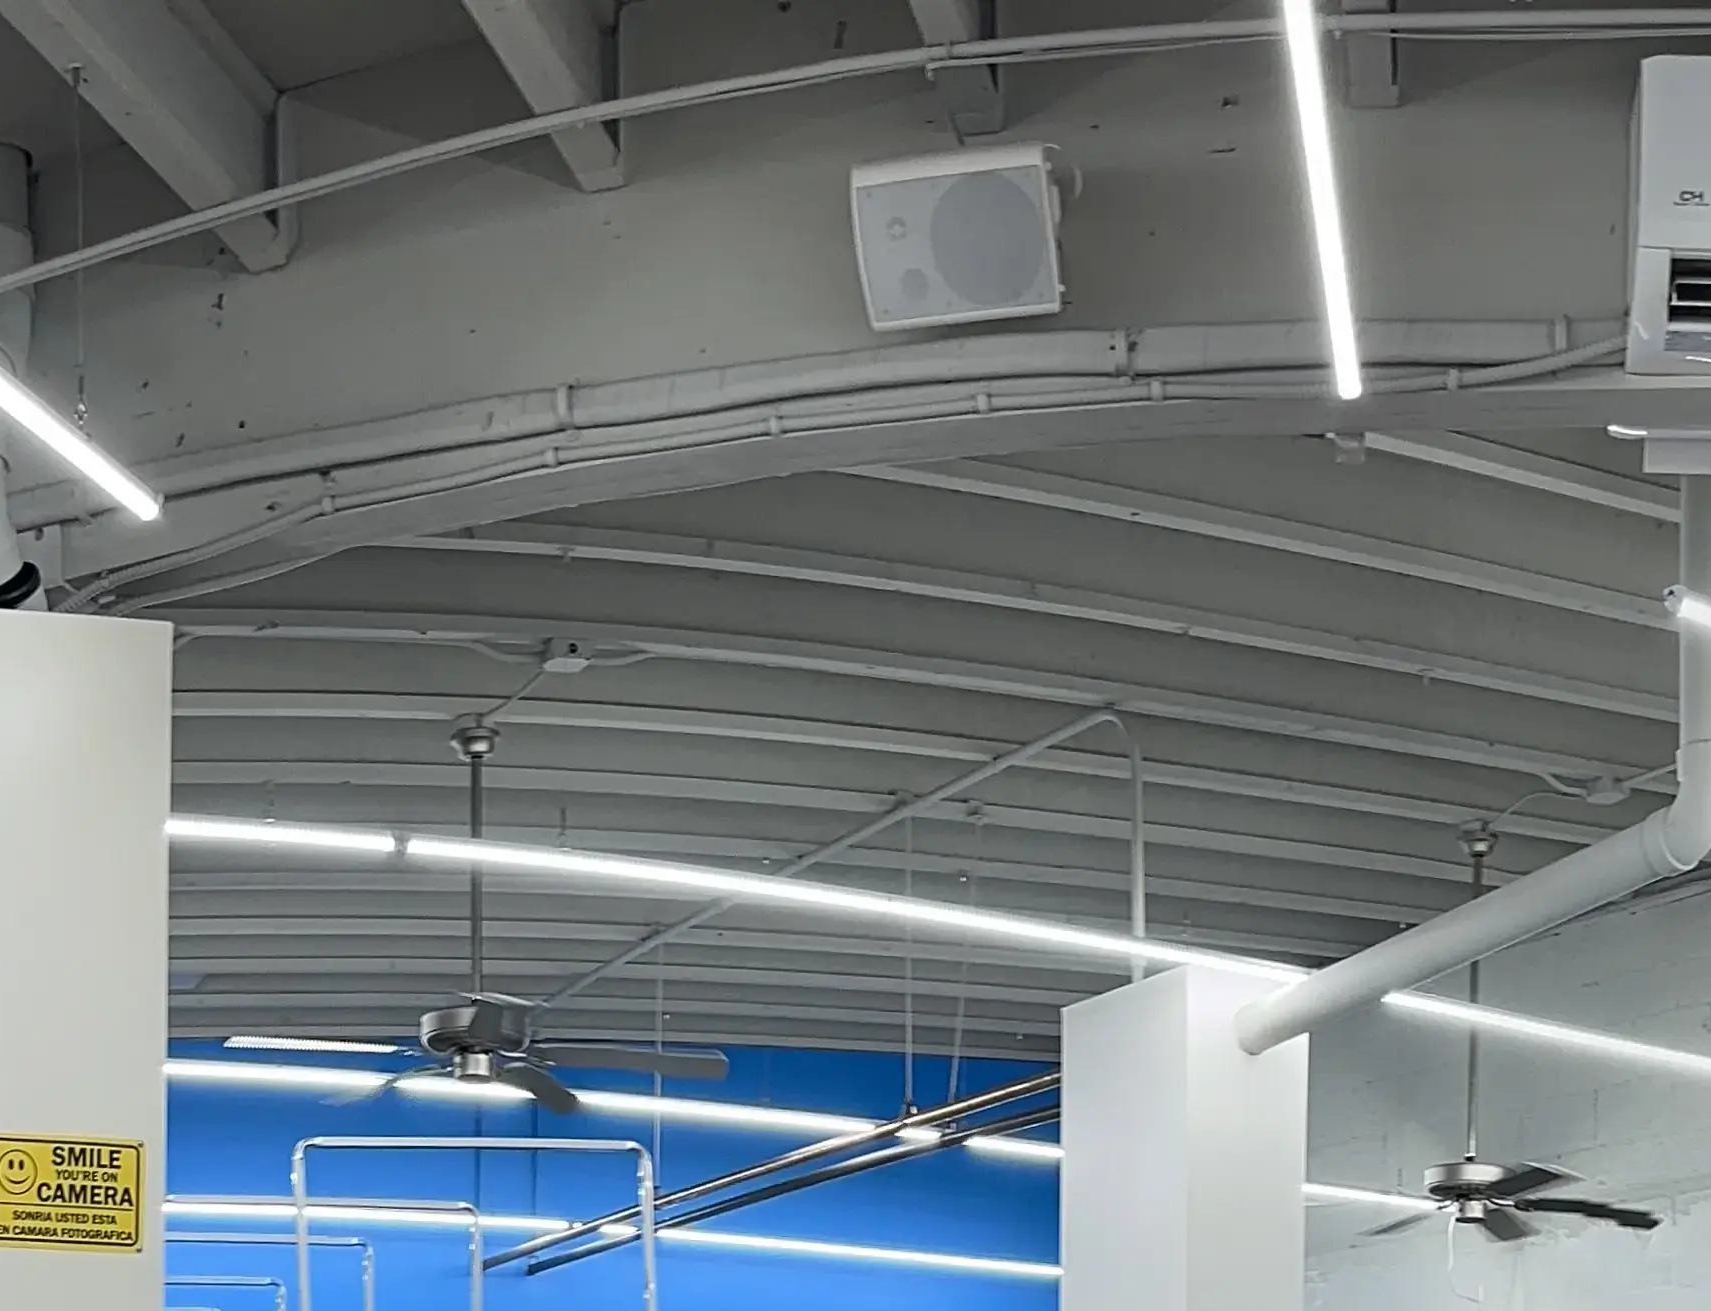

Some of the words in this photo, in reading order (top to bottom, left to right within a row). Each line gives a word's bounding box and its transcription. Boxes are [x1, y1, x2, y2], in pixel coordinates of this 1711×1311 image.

[51, 1145, 122, 1170] SMILE
[55, 1169, 98, 1182] YOU'RE
[101, 1172, 118, 1182] ON
[37, 1182, 134, 1207] CAMERA
[12, 1210, 53, 1222] SONRIA
[55, 1213, 89, 1224] USTED
[92, 1214, 117, 1225] ESTA
[12, 1226, 59, 1238] CAMARA
[61, 1228, 133, 1242] FOTOGRAFICA
